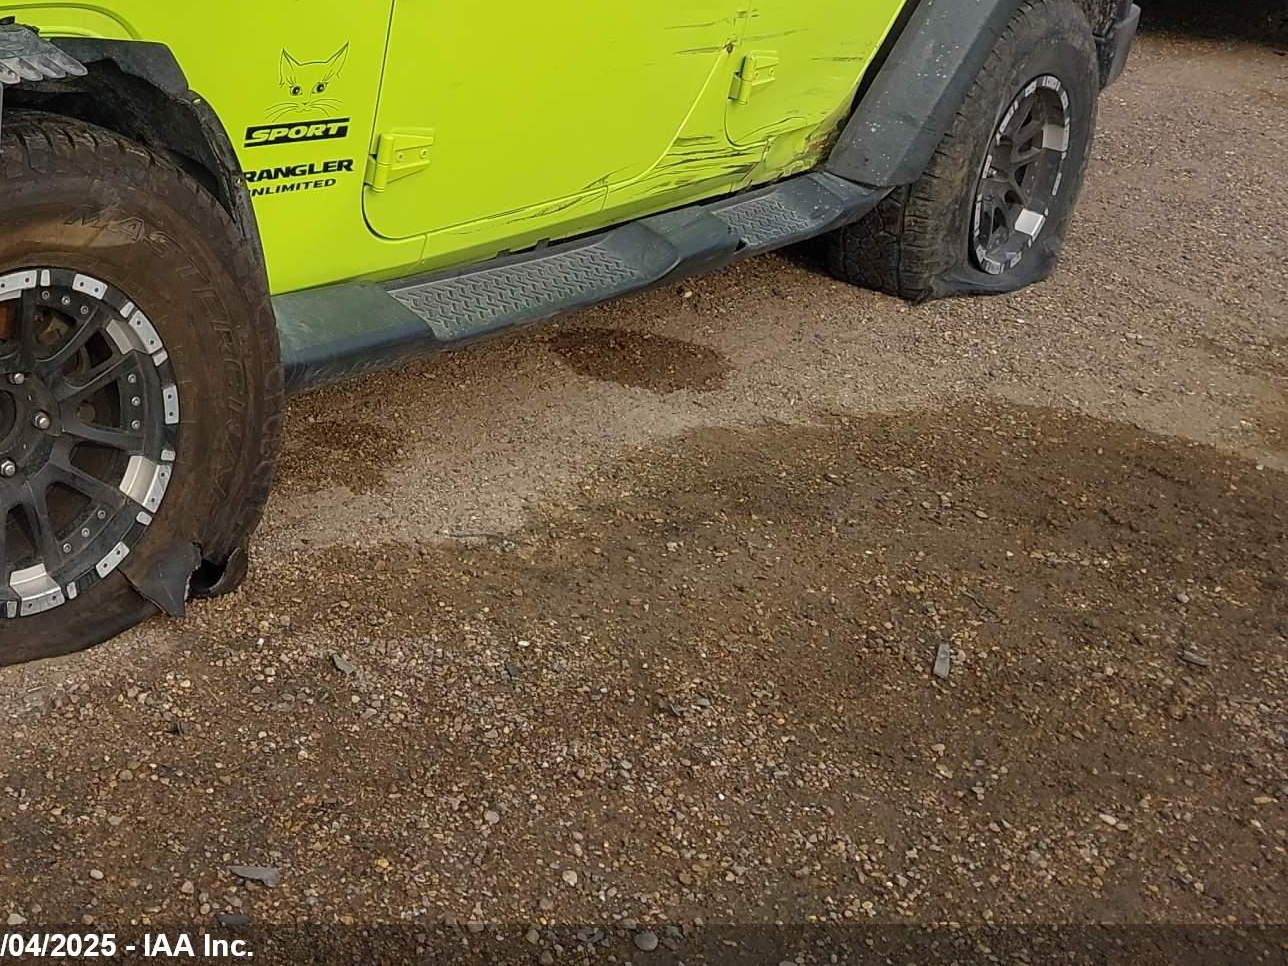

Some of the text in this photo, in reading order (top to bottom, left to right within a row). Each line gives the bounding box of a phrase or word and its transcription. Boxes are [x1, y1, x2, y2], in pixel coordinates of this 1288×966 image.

[244, 121, 349, 145] SPORT
[243, 159, 353, 183] RANGLER
[249, 178, 336, 196] NLIMITED
